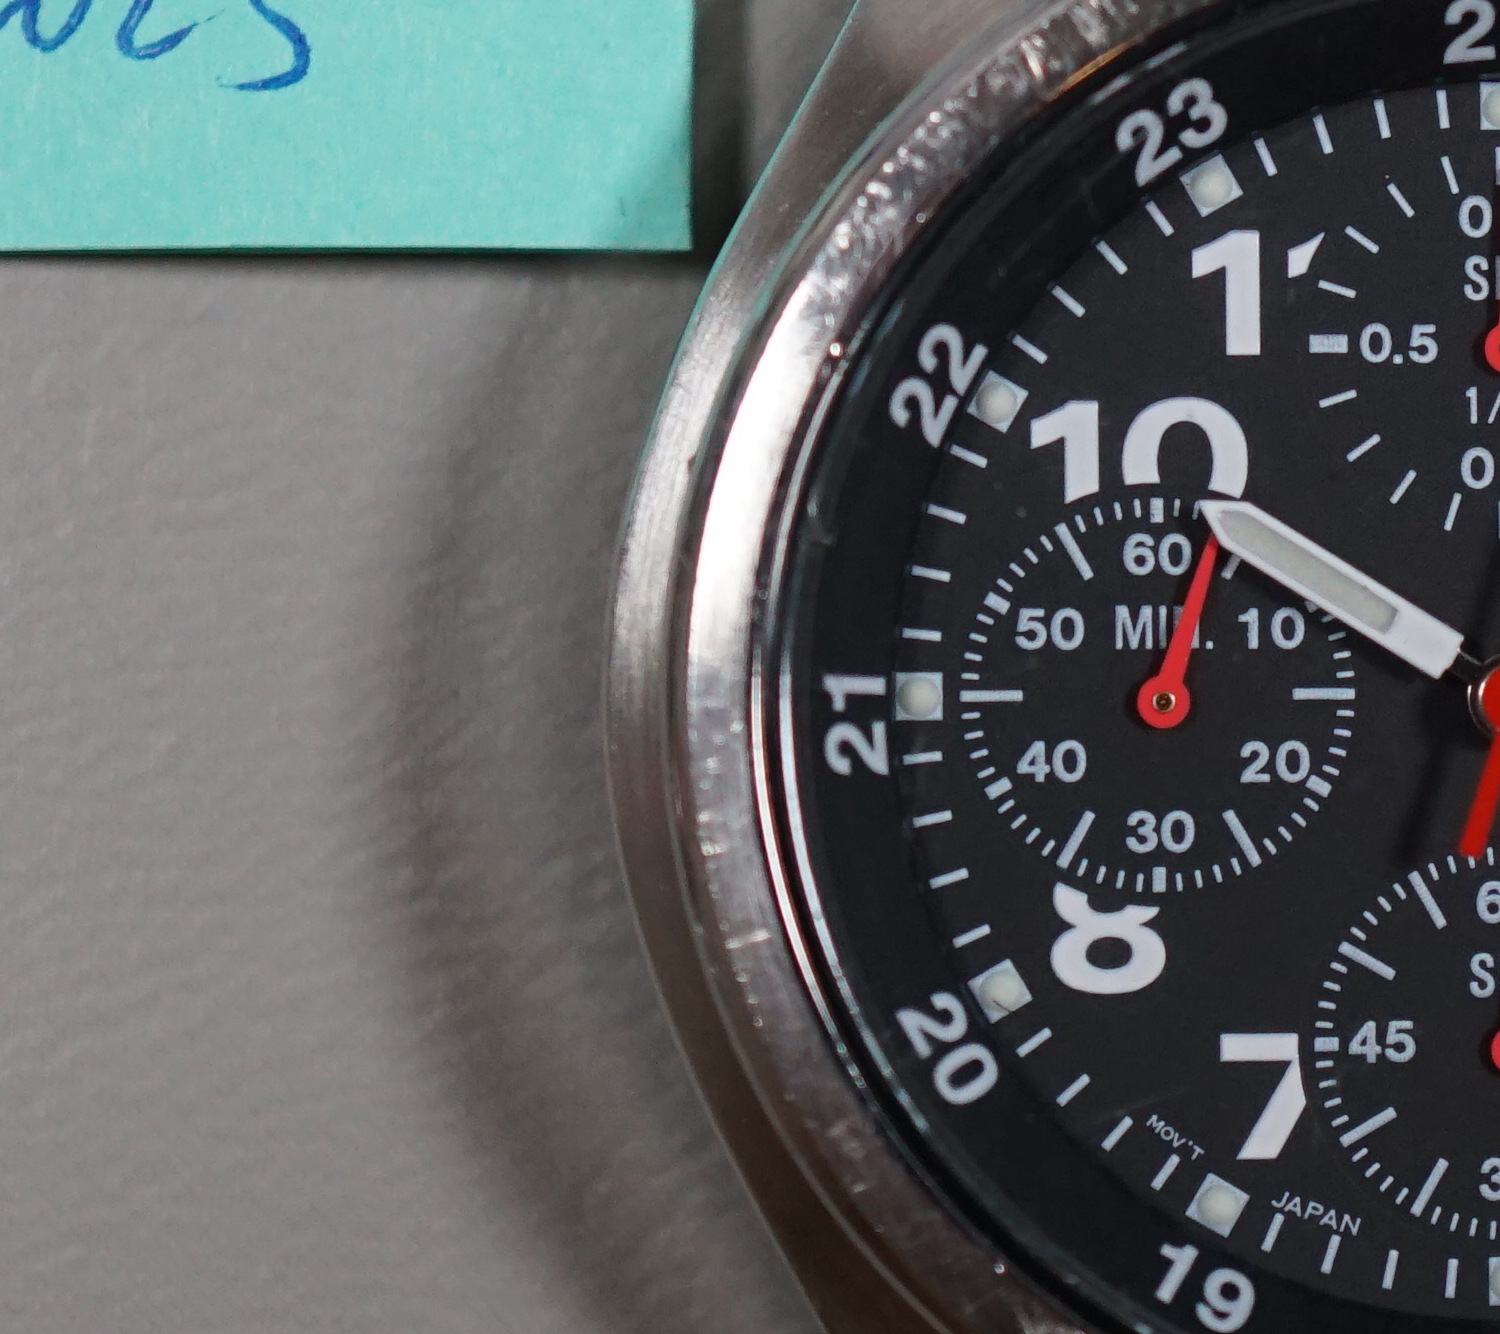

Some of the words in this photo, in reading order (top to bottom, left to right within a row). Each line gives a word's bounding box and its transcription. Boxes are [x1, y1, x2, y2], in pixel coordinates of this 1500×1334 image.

[1114, 78, 1230, 186] 23
[1359, 322, 1439, 365] 0.5
[889, 323, 989, 448] 22
[1030, 396, 1250, 504] 10
[1122, 532, 1193, 576] 60
[1014, 607, 1085, 651] 50
[1237, 606, 1306, 650] 10
[822, 674, 890, 776] 21
[1016, 739, 1088, 783] 40
[1239, 740, 1311, 784] 20
[1125, 810, 1196, 854] 30
[1050, 881, 1167, 995] 8
[896, 991, 999, 1106] 20
[1348, 1020, 1417, 1064] 45
[1220, 1033, 1307, 1160] 7
[1270, 1190, 1362, 1238] JAPAN
[1156, 1243, 1256, 1333] 19
